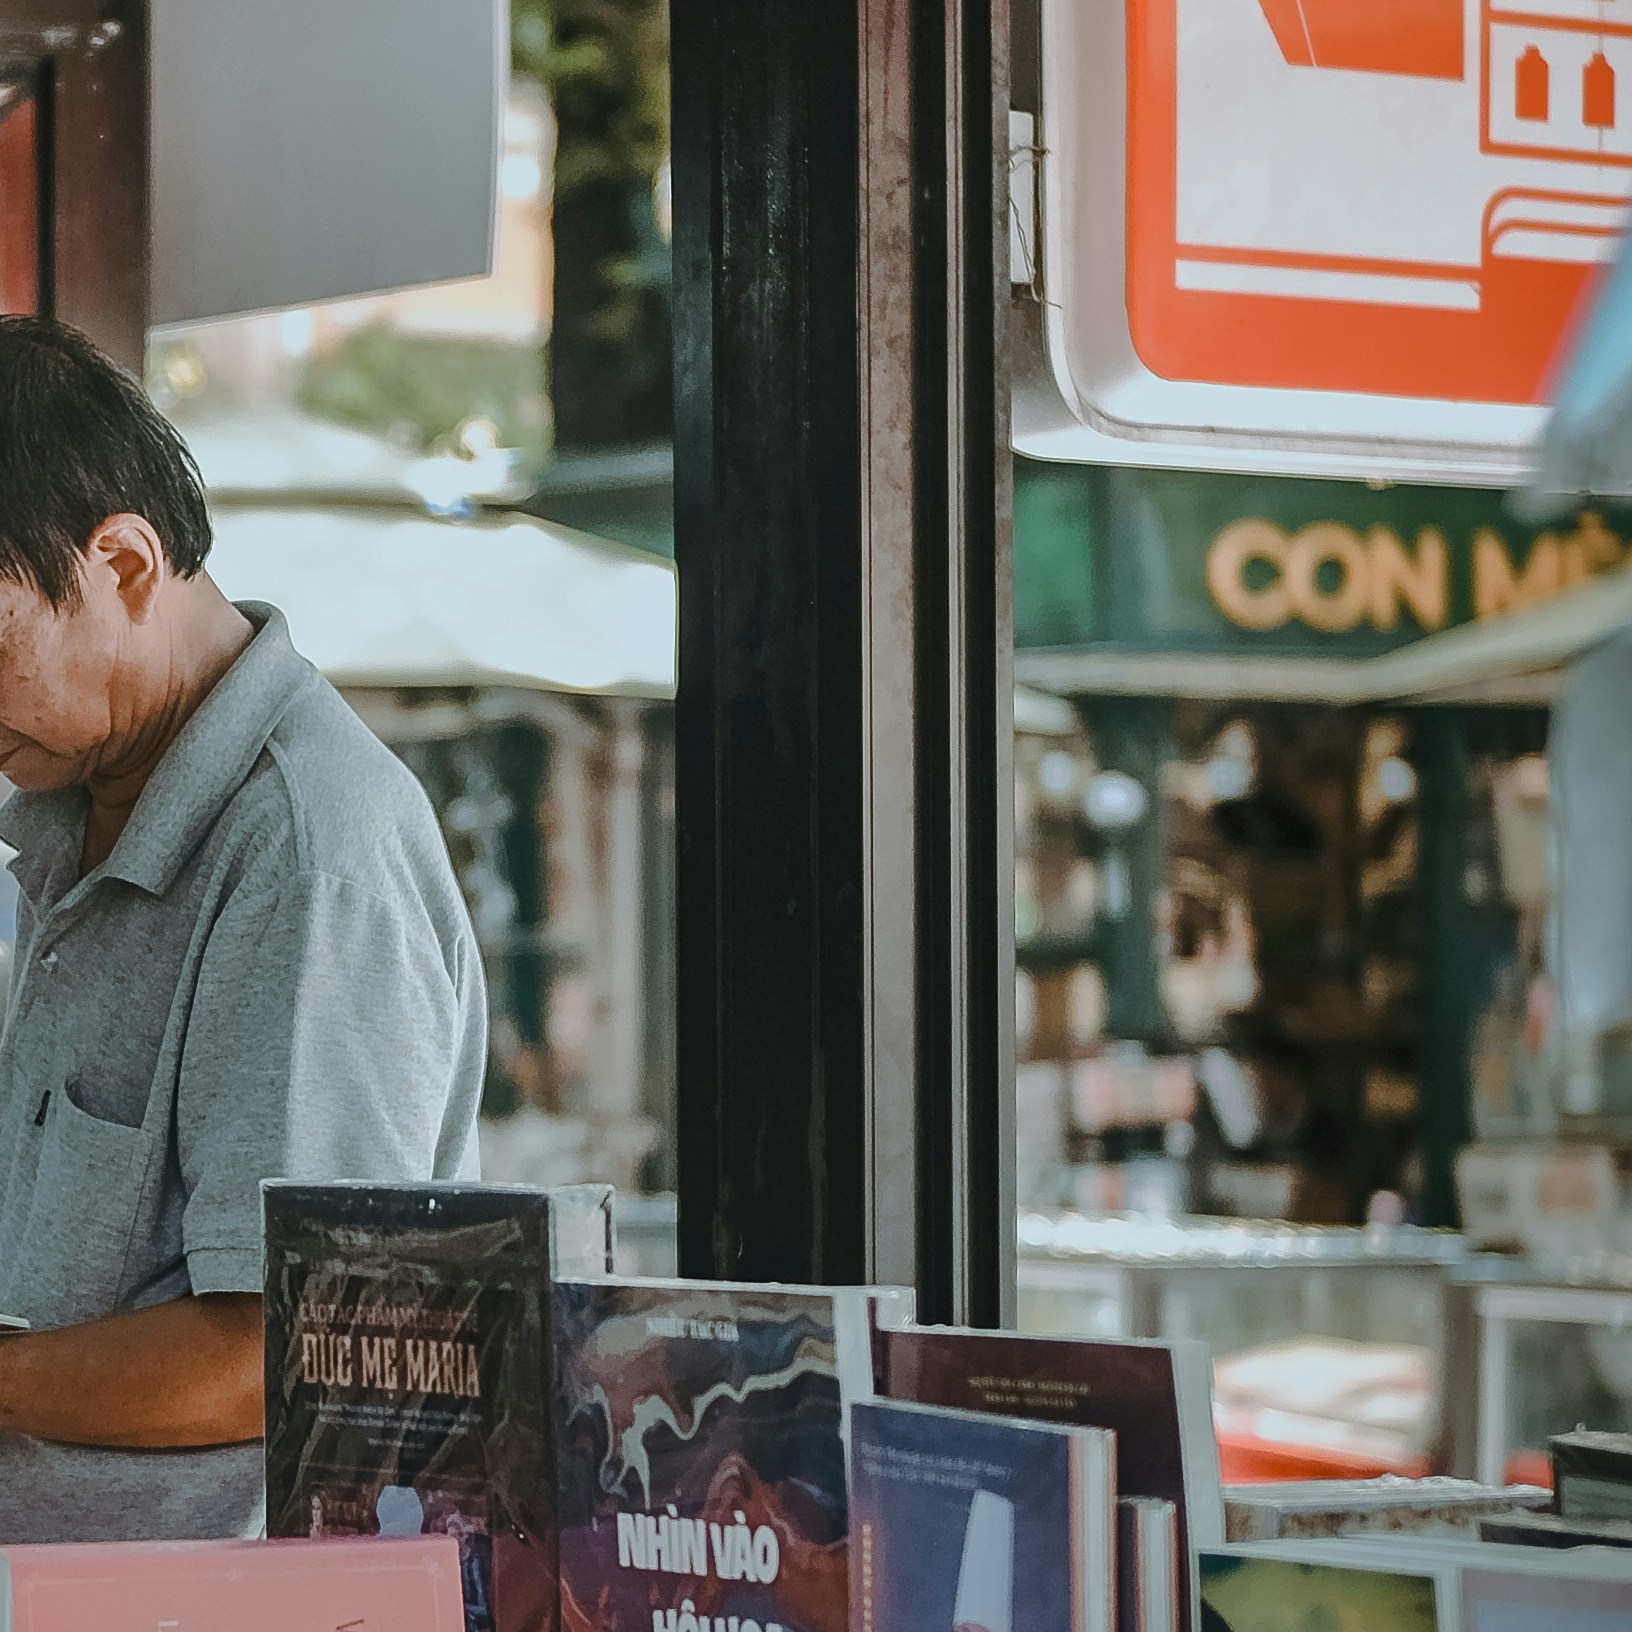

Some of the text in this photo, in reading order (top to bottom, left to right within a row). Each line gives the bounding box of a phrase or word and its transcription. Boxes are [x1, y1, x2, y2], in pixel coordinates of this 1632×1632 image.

[1206, 518, 1451, 632] CON
[361, 1335, 398, 1399] MẸ
[405, 1339, 480, 1398] MARIA
[617, 1504, 707, 1576] NHÌN
[710, 1510, 779, 1584] VÀO
